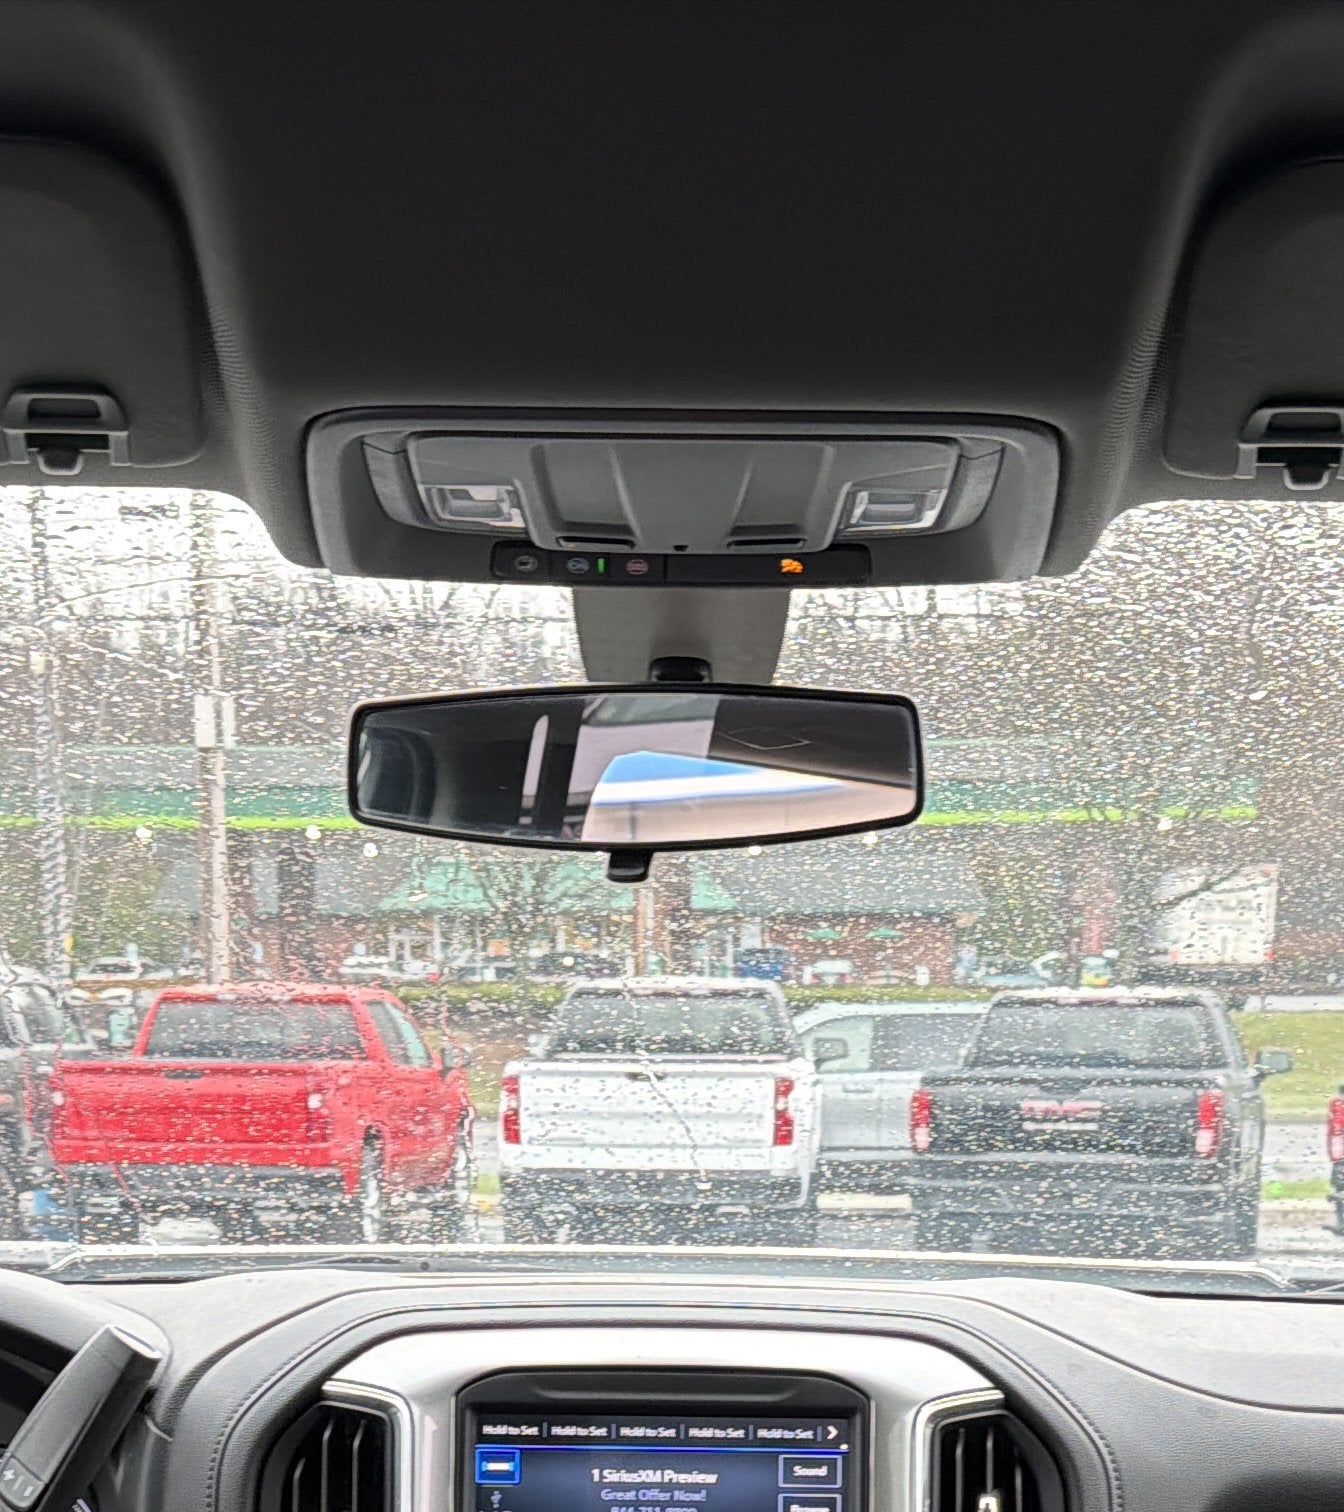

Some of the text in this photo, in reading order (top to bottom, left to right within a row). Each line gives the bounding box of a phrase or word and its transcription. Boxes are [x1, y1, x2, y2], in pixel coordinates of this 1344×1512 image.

[663, 1470, 719, 1484] Preview
[600, 1488, 637, 1501] Great
[638, 1489, 672, 1501] Offer
